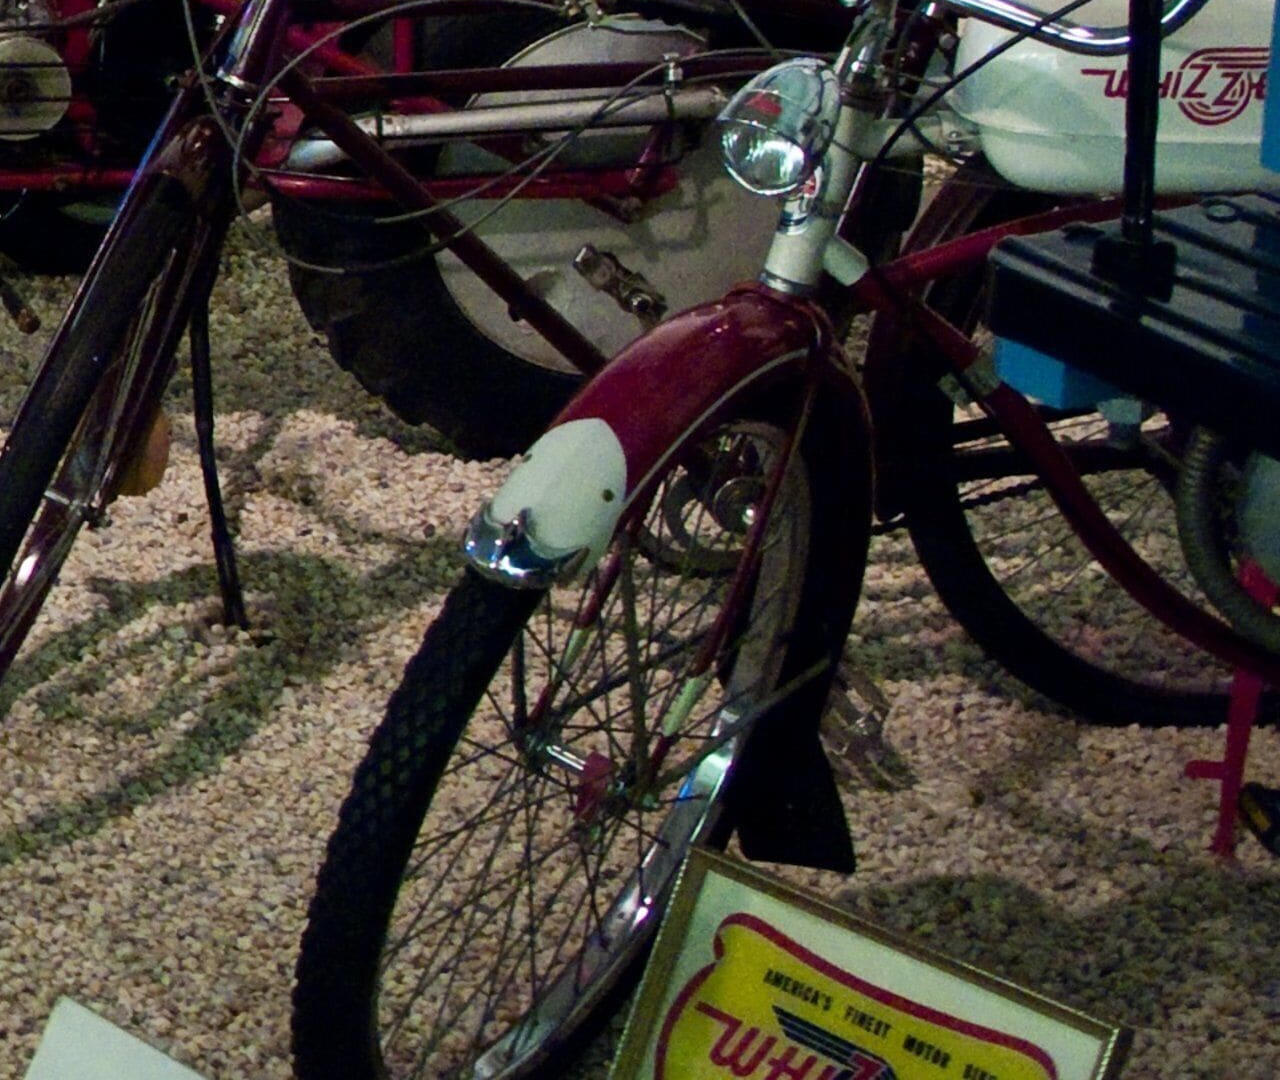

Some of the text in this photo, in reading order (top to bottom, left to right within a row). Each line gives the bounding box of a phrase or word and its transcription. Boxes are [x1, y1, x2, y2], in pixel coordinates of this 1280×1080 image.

[764, 968, 951, 1069] AMERICA'S FINEST MOTOR
